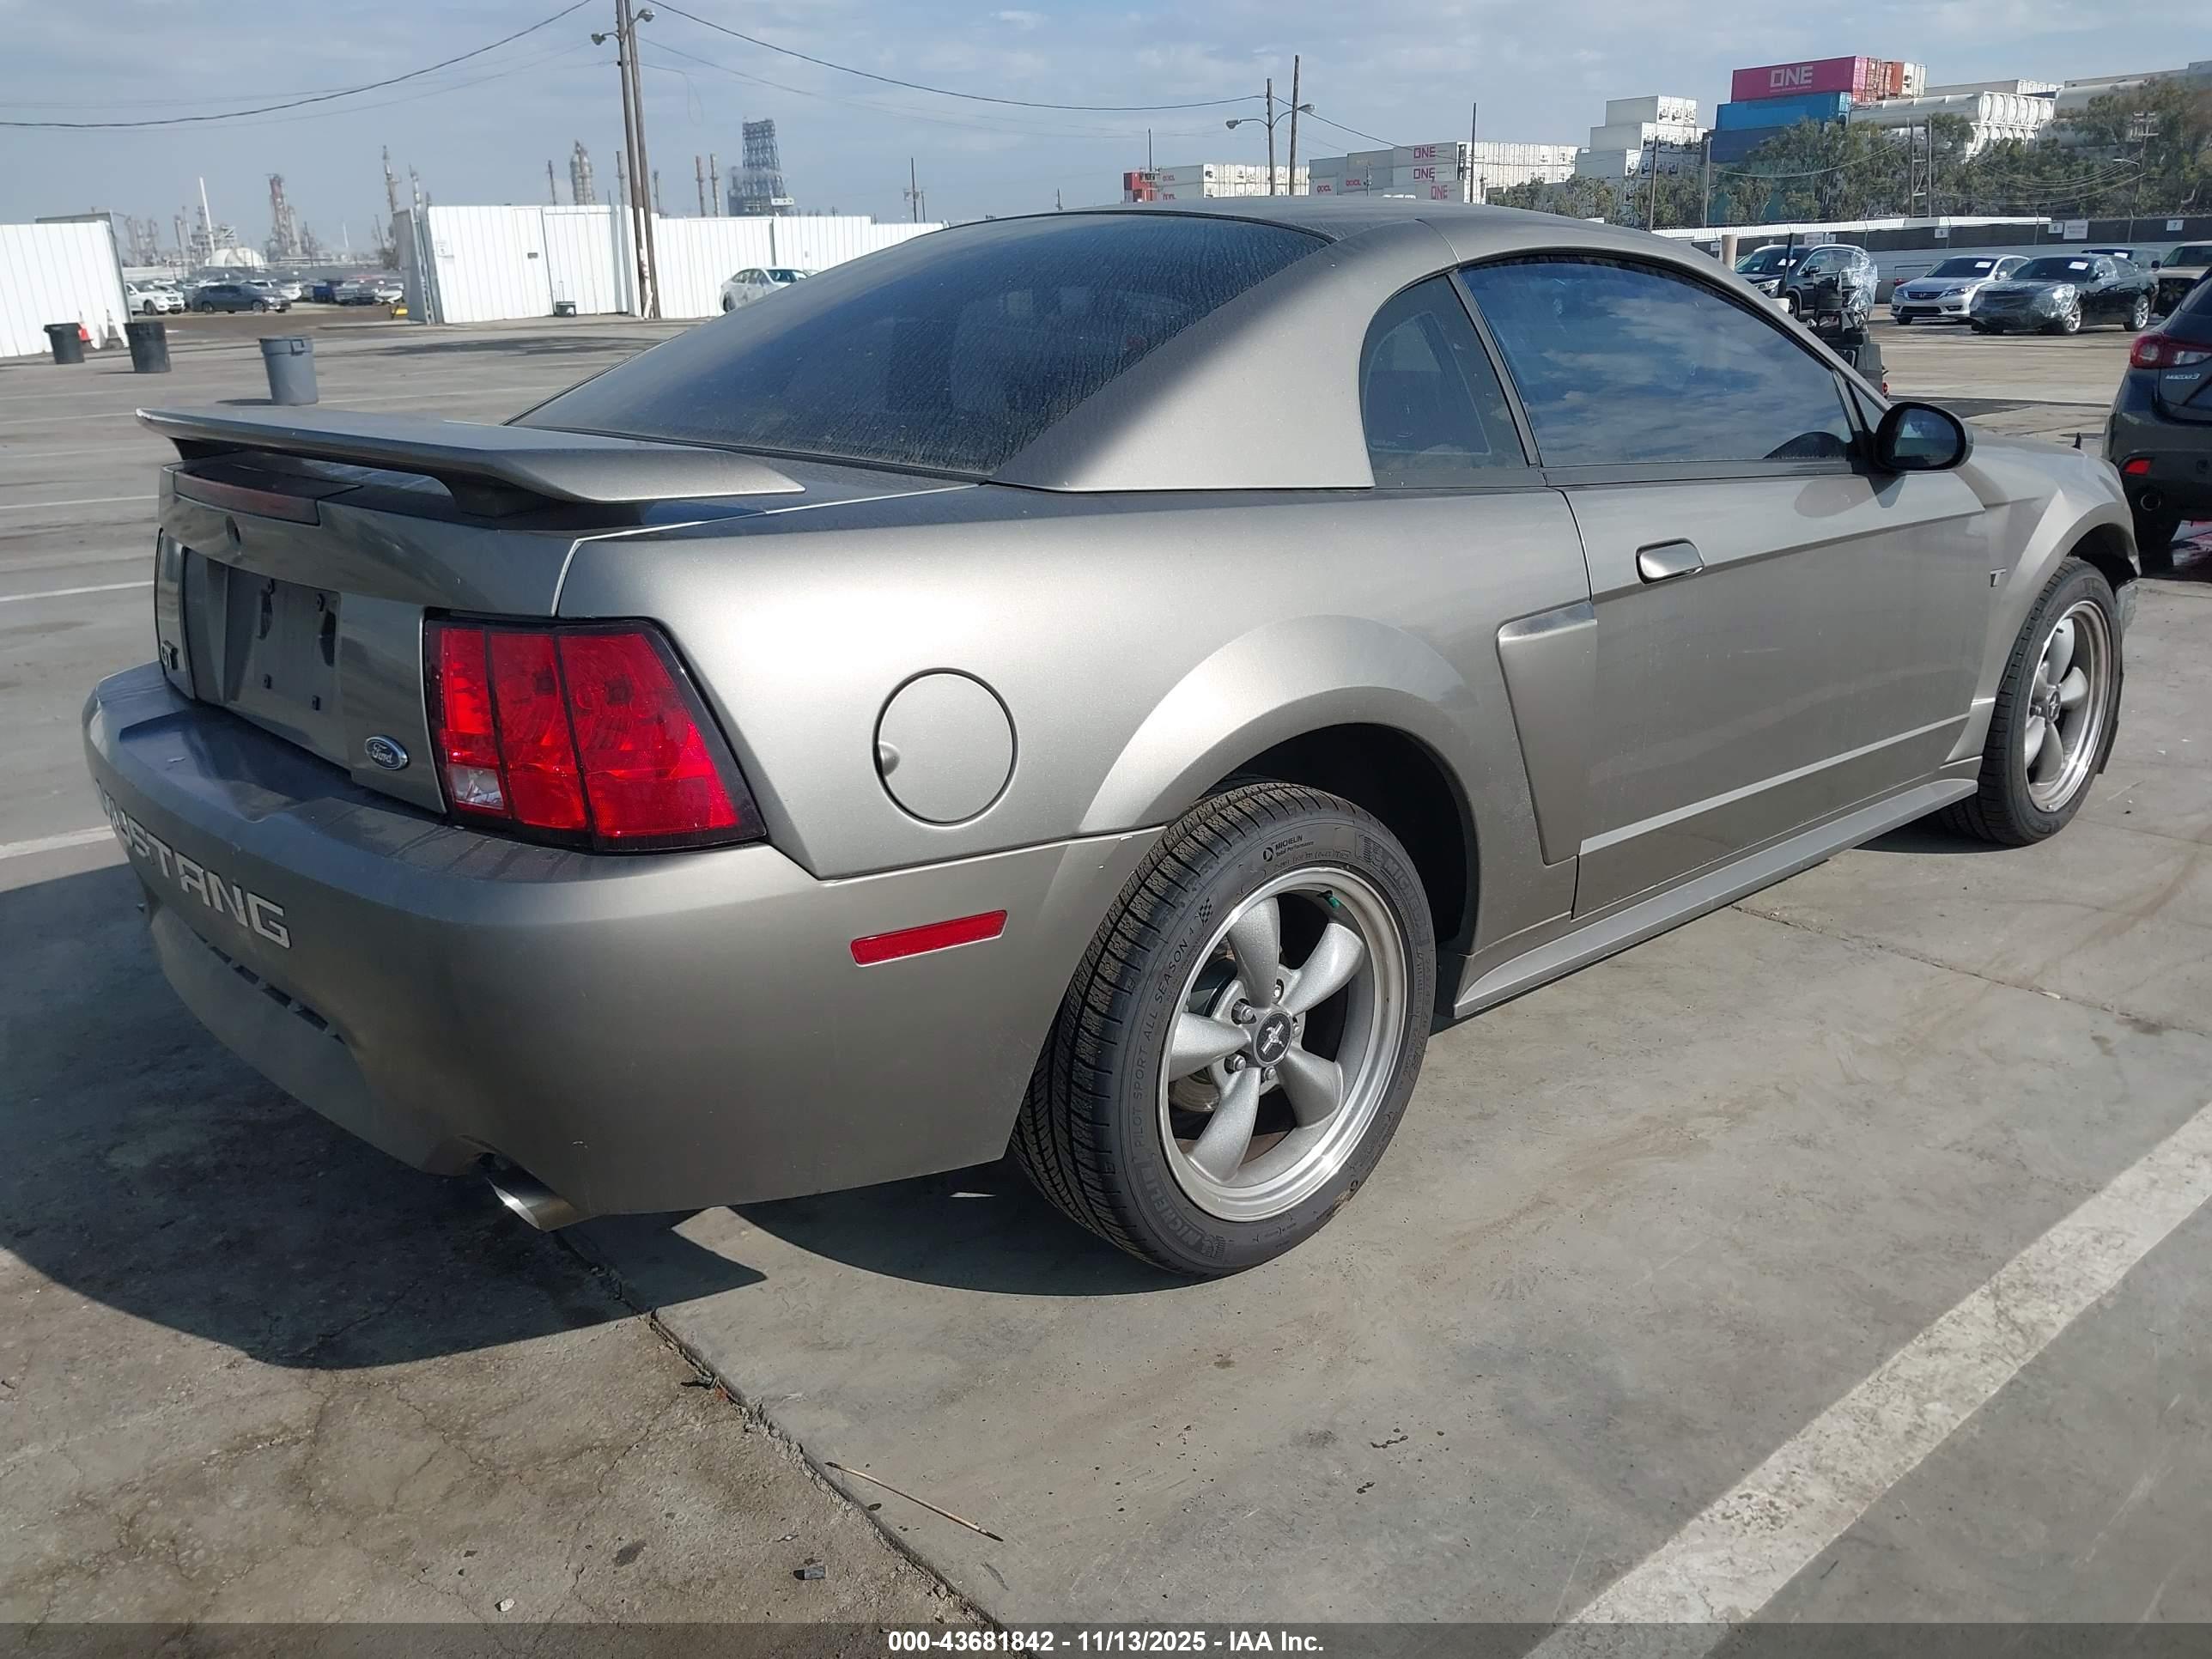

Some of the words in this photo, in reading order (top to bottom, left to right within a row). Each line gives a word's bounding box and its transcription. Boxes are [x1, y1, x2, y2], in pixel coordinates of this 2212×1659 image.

[1770, 66, 1814, 88] ONE
[1413, 147, 1436, 158] ONE
[1413, 167, 1435, 179] ONE
[372, 742, 393, 763] Ford
[1275, 835, 1303, 850] MICHELIN
[95, 778, 291, 949] MUSTANG
[1154, 938, 1188, 1004] SEASON
[1145, 1011, 1158, 1041] ALL
[1133, 1049, 1149, 1101] SPORT
[1133, 1111, 1143, 1148] PILOT
